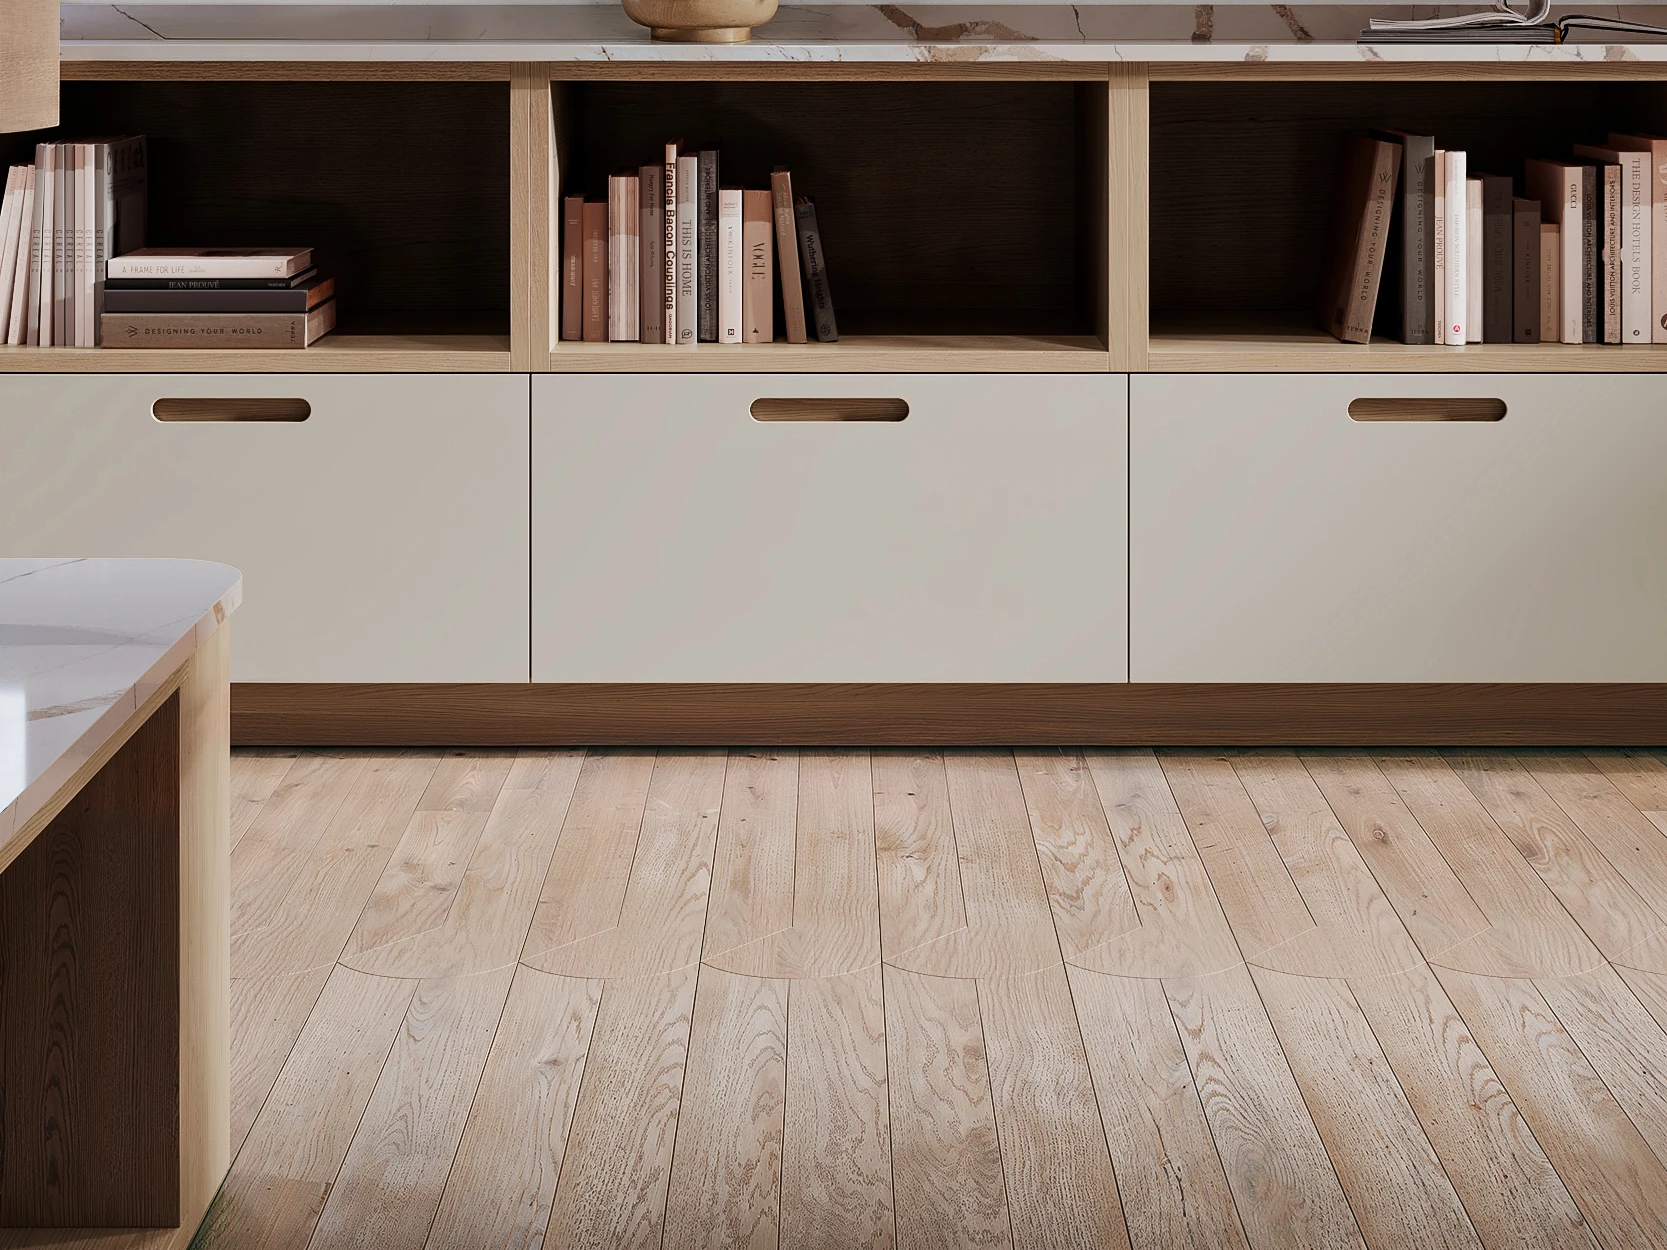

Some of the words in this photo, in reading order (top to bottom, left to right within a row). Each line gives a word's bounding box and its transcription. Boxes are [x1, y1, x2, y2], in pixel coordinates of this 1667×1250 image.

[666, 162, 674, 206] Francis
[1632, 158, 1640, 180] THE
[1372, 190, 1385, 237] DESIGNING
[1632, 182, 1640, 219] DESIGN
[666, 210, 674, 246] Bacon
[682, 220, 692, 246] THIS
[1632, 221, 1640, 263] HOTELS
[32, 230, 40, 264] CEREAL
[682, 248, 692, 264] IS
[1367, 242, 1377, 265] YOUR
[1436, 241, 1444, 269] PROUVÉ
[122, 266, 127, 274] A
[130, 266, 152, 274] FRAME
[156, 266, 169, 274] FOR
[172, 266, 184, 274] LIFE
[189, 280, 220, 288] PROUVÉ
[666, 250, 674, 310] Couplings
[682, 266, 692, 296] HOME
[806, 234, 818, 277] Wuthering
[814, 279, 824, 309] Heights
[1632, 267, 1640, 294] BOOK
[1361, 271, 1371, 301] WORLD
